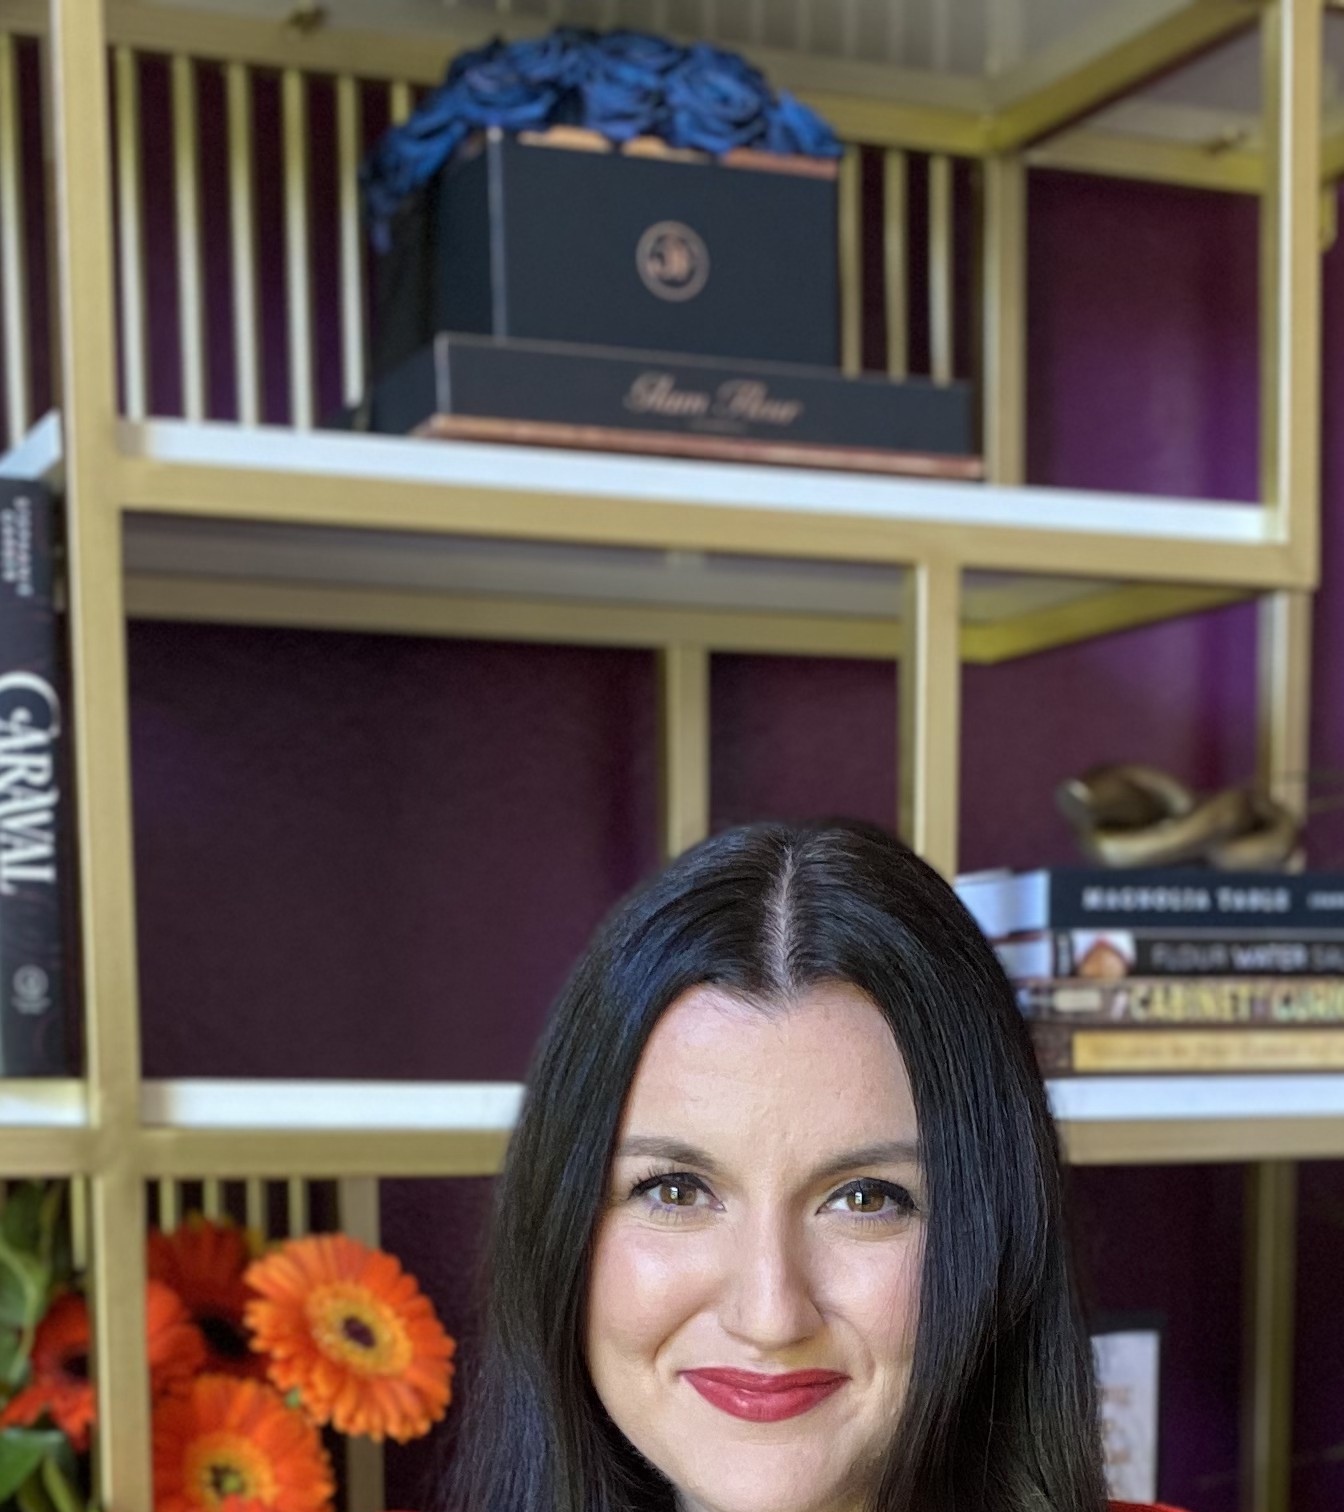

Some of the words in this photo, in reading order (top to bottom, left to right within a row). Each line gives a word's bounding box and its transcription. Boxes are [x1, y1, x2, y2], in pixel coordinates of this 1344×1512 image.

[1151, 943, 1228, 970] FLOUR
[1231, 943, 1307, 970] WATER
[1129, 982, 1254, 1022] CABINET
